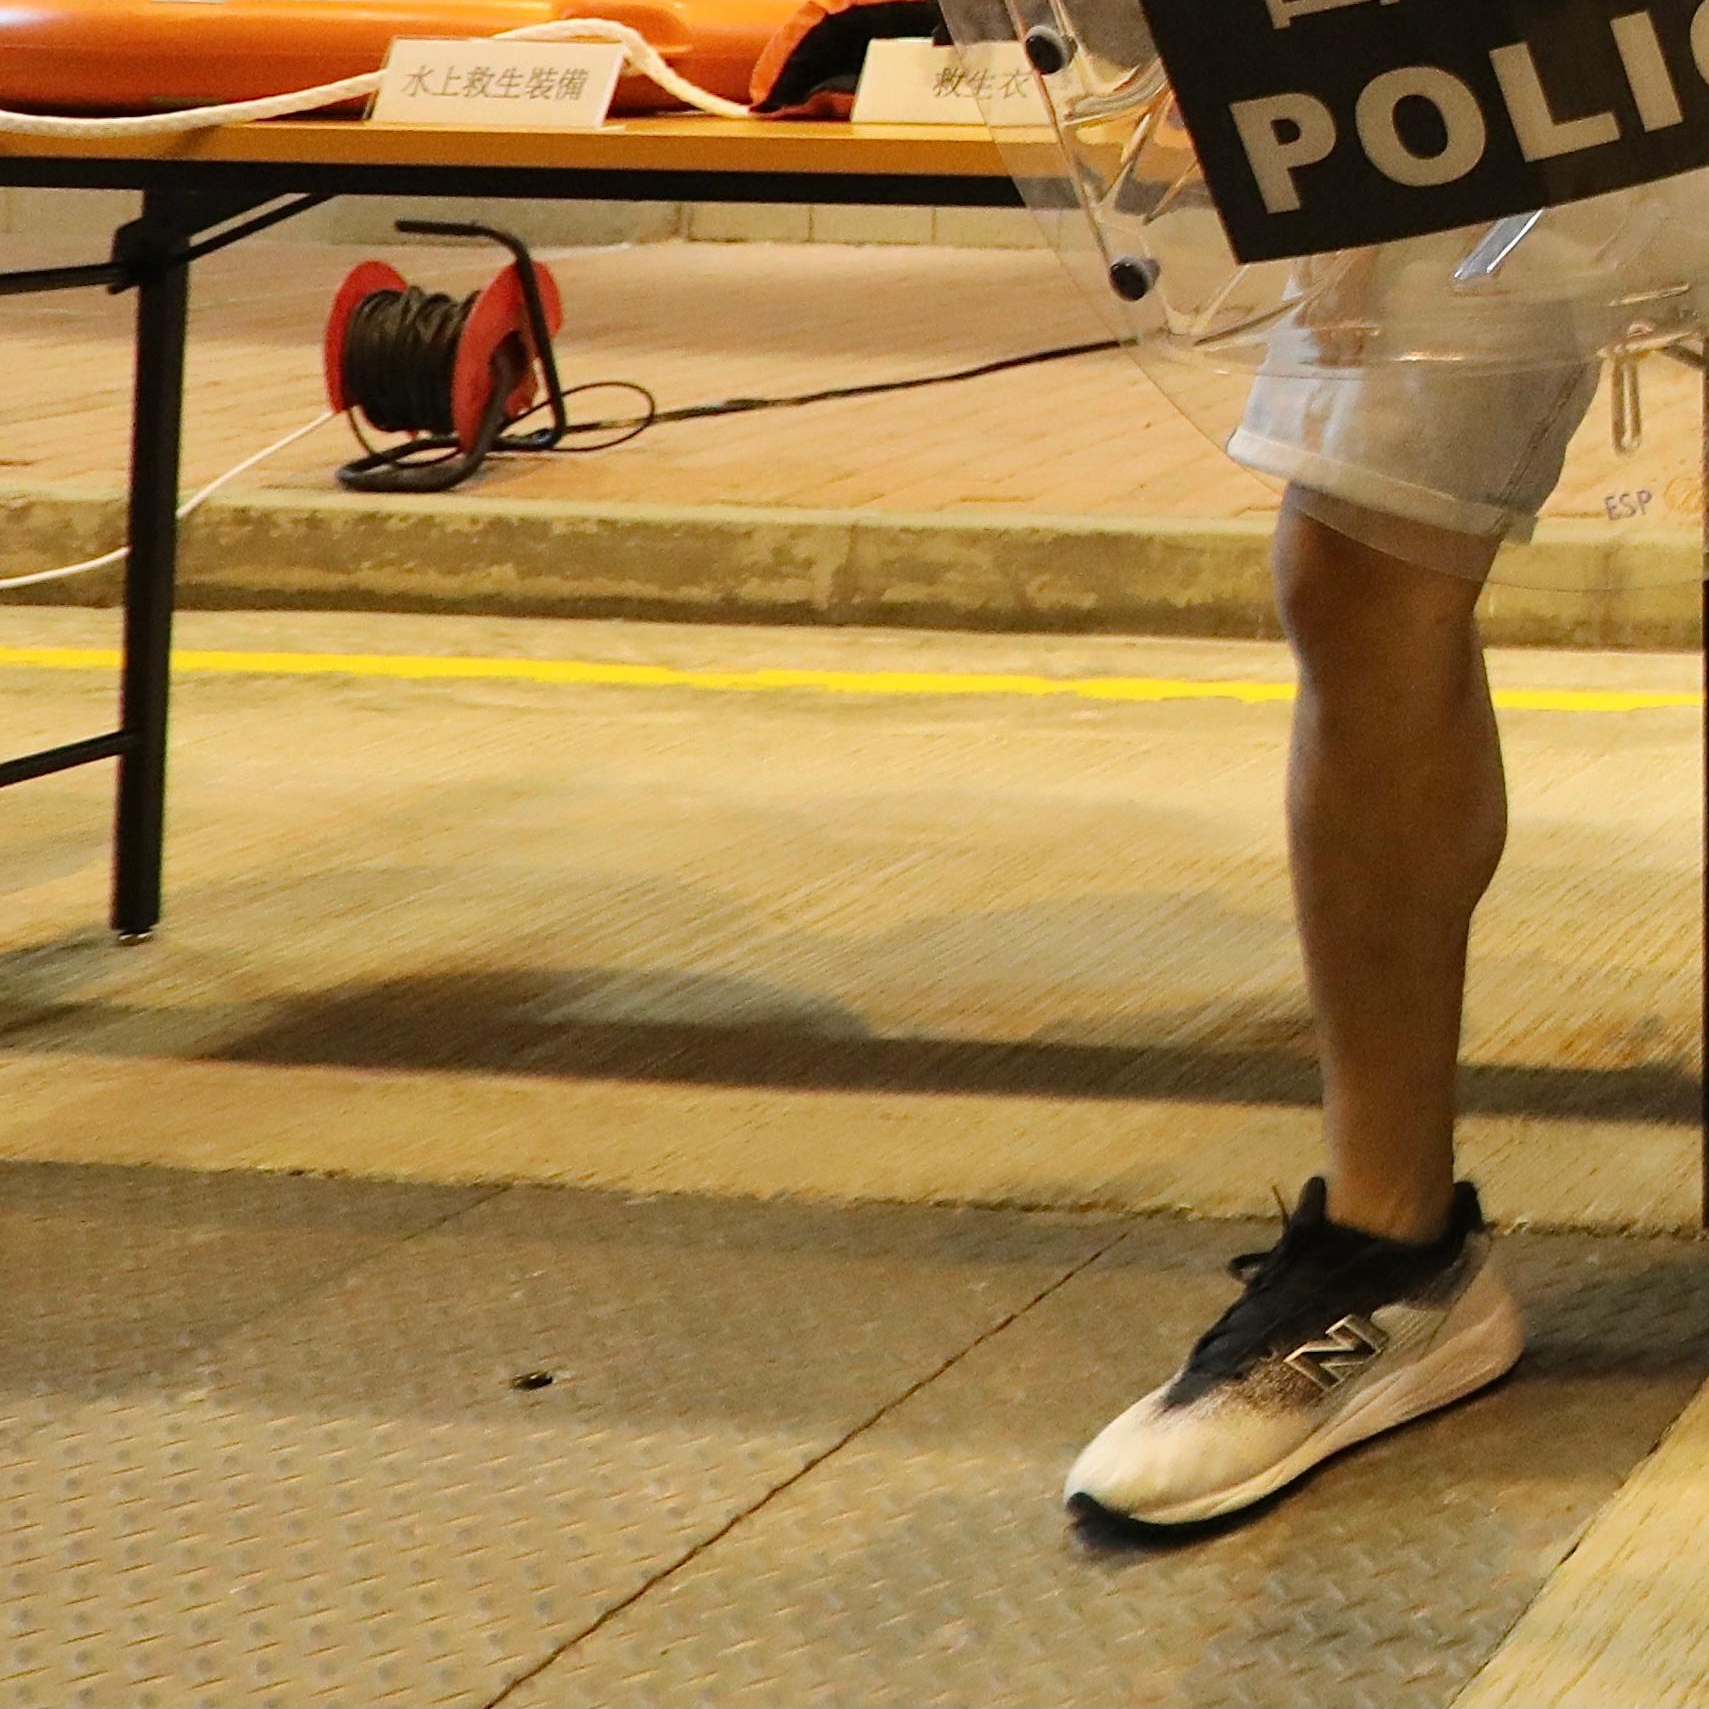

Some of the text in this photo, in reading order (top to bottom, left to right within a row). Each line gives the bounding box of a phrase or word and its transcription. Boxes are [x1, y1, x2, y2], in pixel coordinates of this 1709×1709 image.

[402, 65, 589, 101] 水上救生裝備
[932, 67, 1029, 101] 救生衣
